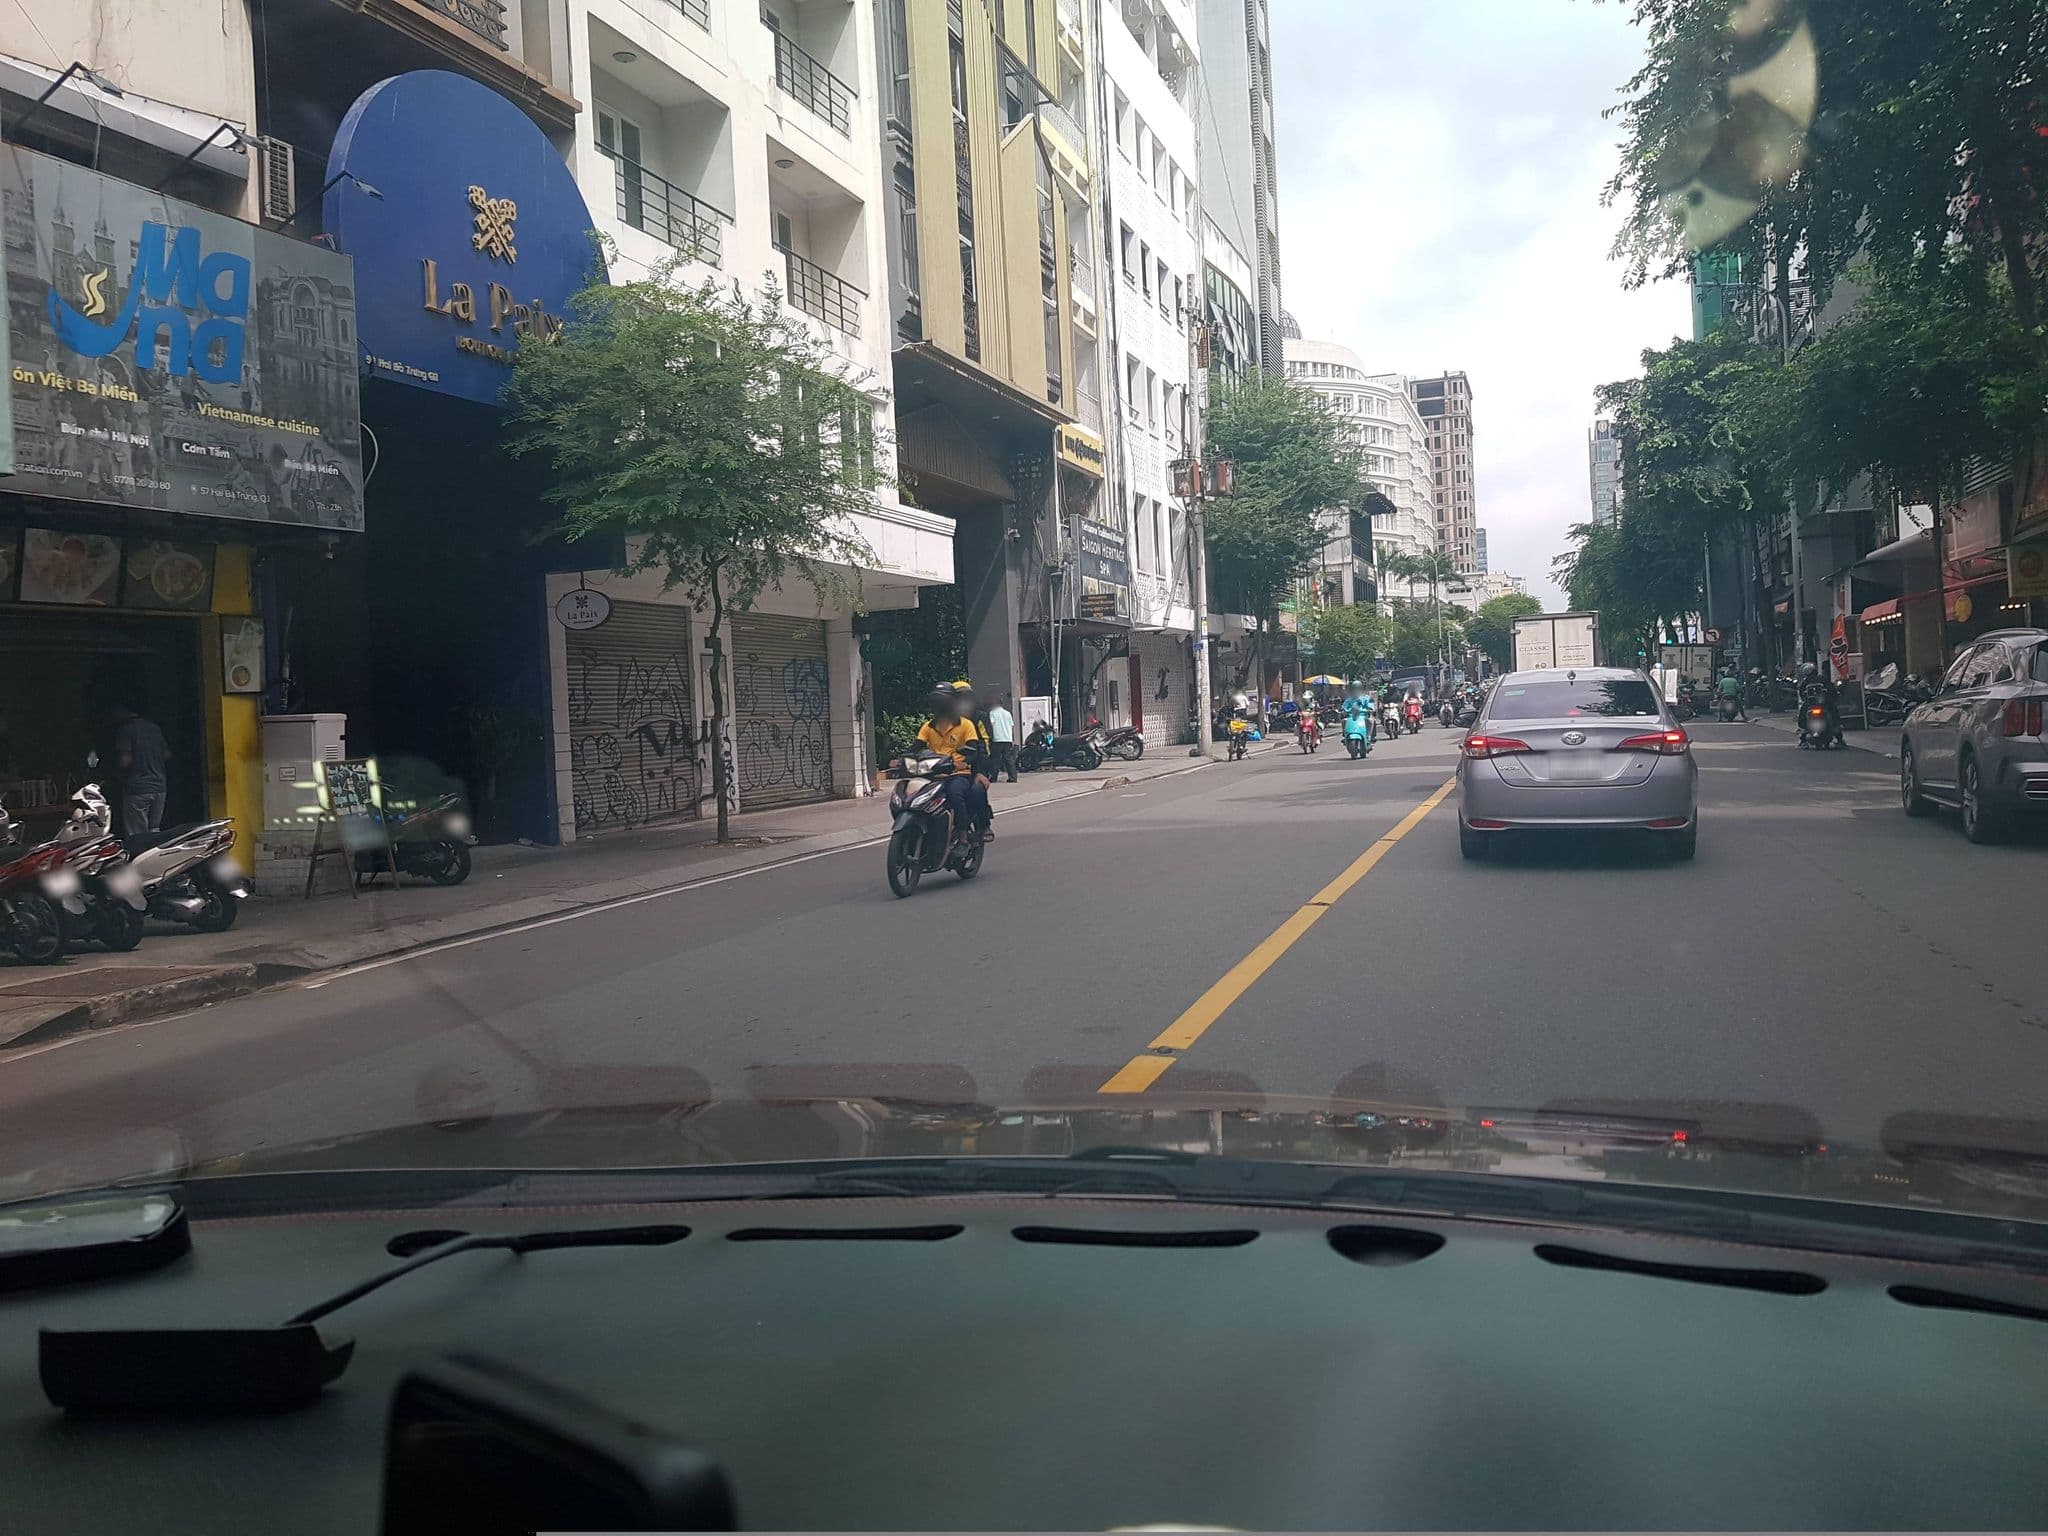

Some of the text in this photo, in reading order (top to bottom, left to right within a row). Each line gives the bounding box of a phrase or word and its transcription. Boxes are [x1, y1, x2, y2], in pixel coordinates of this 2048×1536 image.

[422, 257, 565, 347] La Paix
[38, 371, 73, 393] Việt
[76, 379, 97, 395] Ba
[197, 401, 321, 436] Vietnamese cuisine
[60, 422, 86, 436] Bún
[130, 433, 150, 449] Nội
[181, 442, 207, 455] Cơm
[567, 610, 599, 620] La Paix
[1520, 645, 1550, 655] CLASSIC
